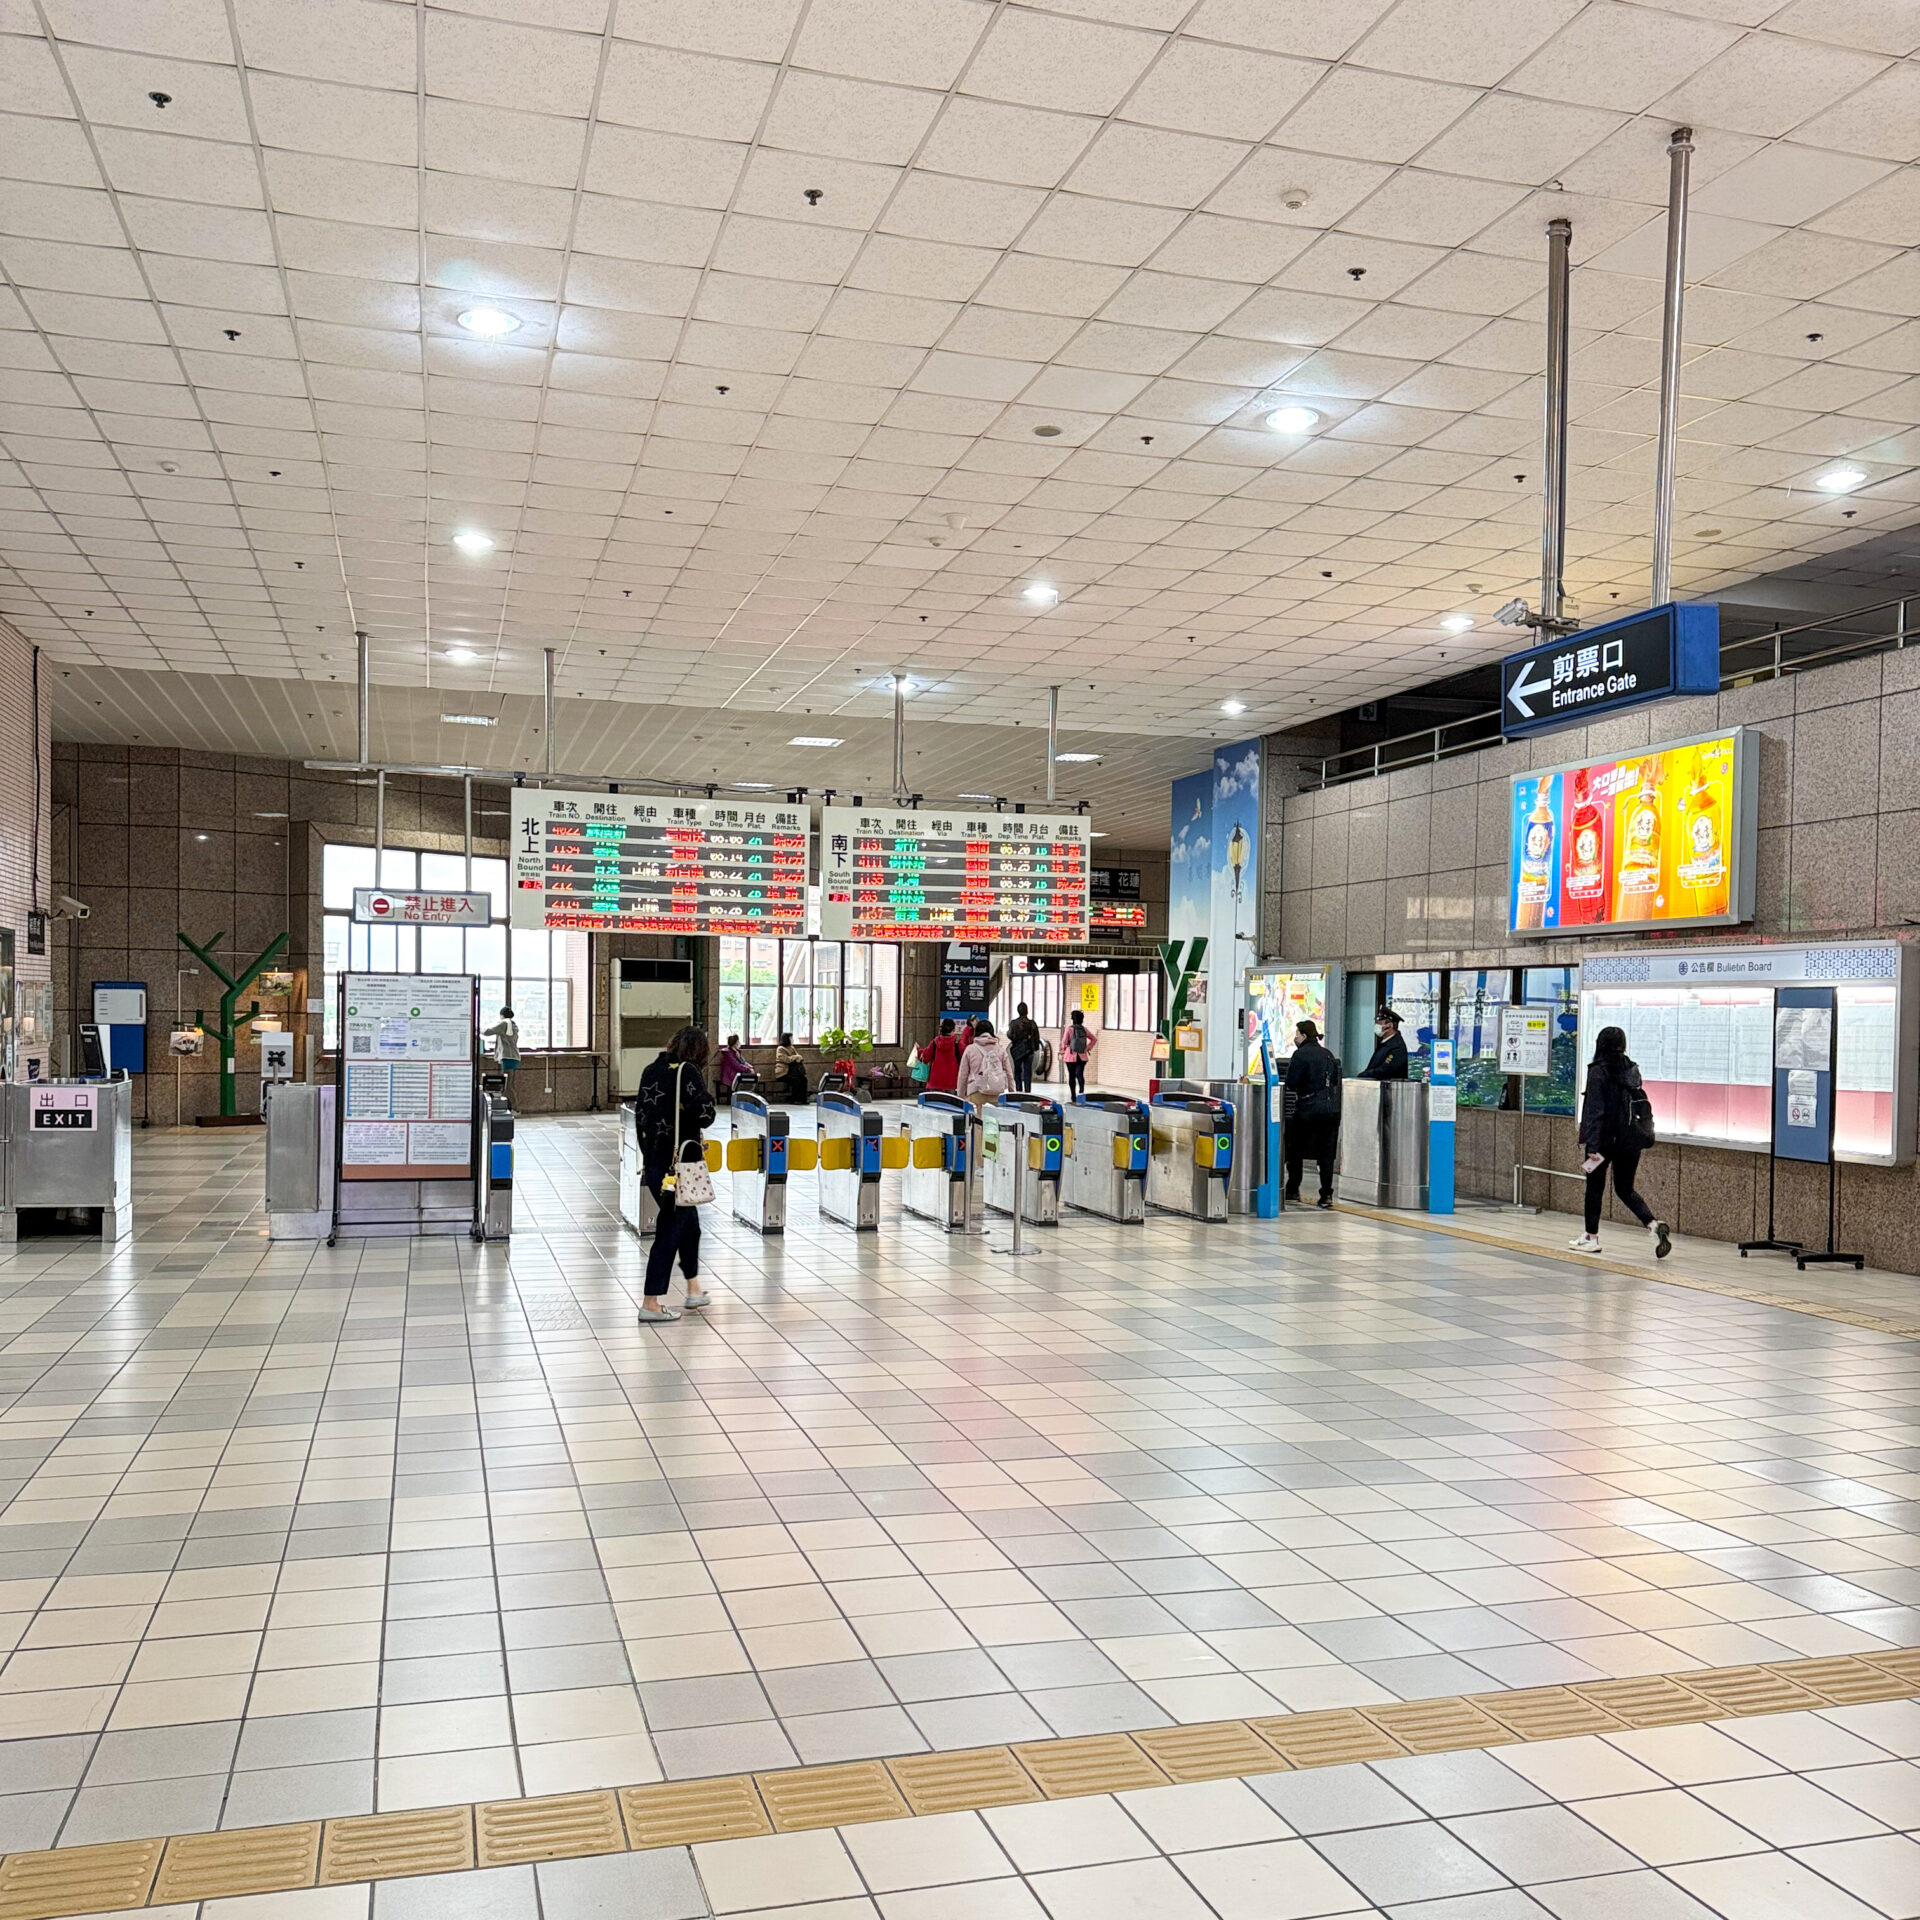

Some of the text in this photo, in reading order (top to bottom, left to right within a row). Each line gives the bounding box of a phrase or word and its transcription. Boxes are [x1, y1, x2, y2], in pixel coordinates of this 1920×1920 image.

[1553, 639, 1623, 686] 剪票口
[1552, 672, 1637, 708] Entrance Gate
[549, 811, 567, 819] Train
[585, 814, 626, 822] Destination
[686, 819, 702, 827] Type
[553, 801, 798, 825] 車次 開往 經由 車種 時間 月台 備註
[860, 818, 882, 829] 車次
[896, 819, 917, 830] 開往
[931, 820, 952, 831] 經由
[967, 822, 987, 833] 車種
[1003, 823, 1024, 834] 時間
[1029, 824, 1048, 834] 月台
[521, 817, 540, 854] 北上
[831, 834, 848, 868] 南下
[517, 863, 544, 871] Bound
[405, 895, 474, 913] 禁止進入
[404, 912, 451, 923] No Entry
[944, 963, 959, 973] 北上
[1717, 961, 1772, 972] Bulletin Board
[40, 1093, 88, 1107] 出口
[43, 1113, 85, 1125] EXIT
